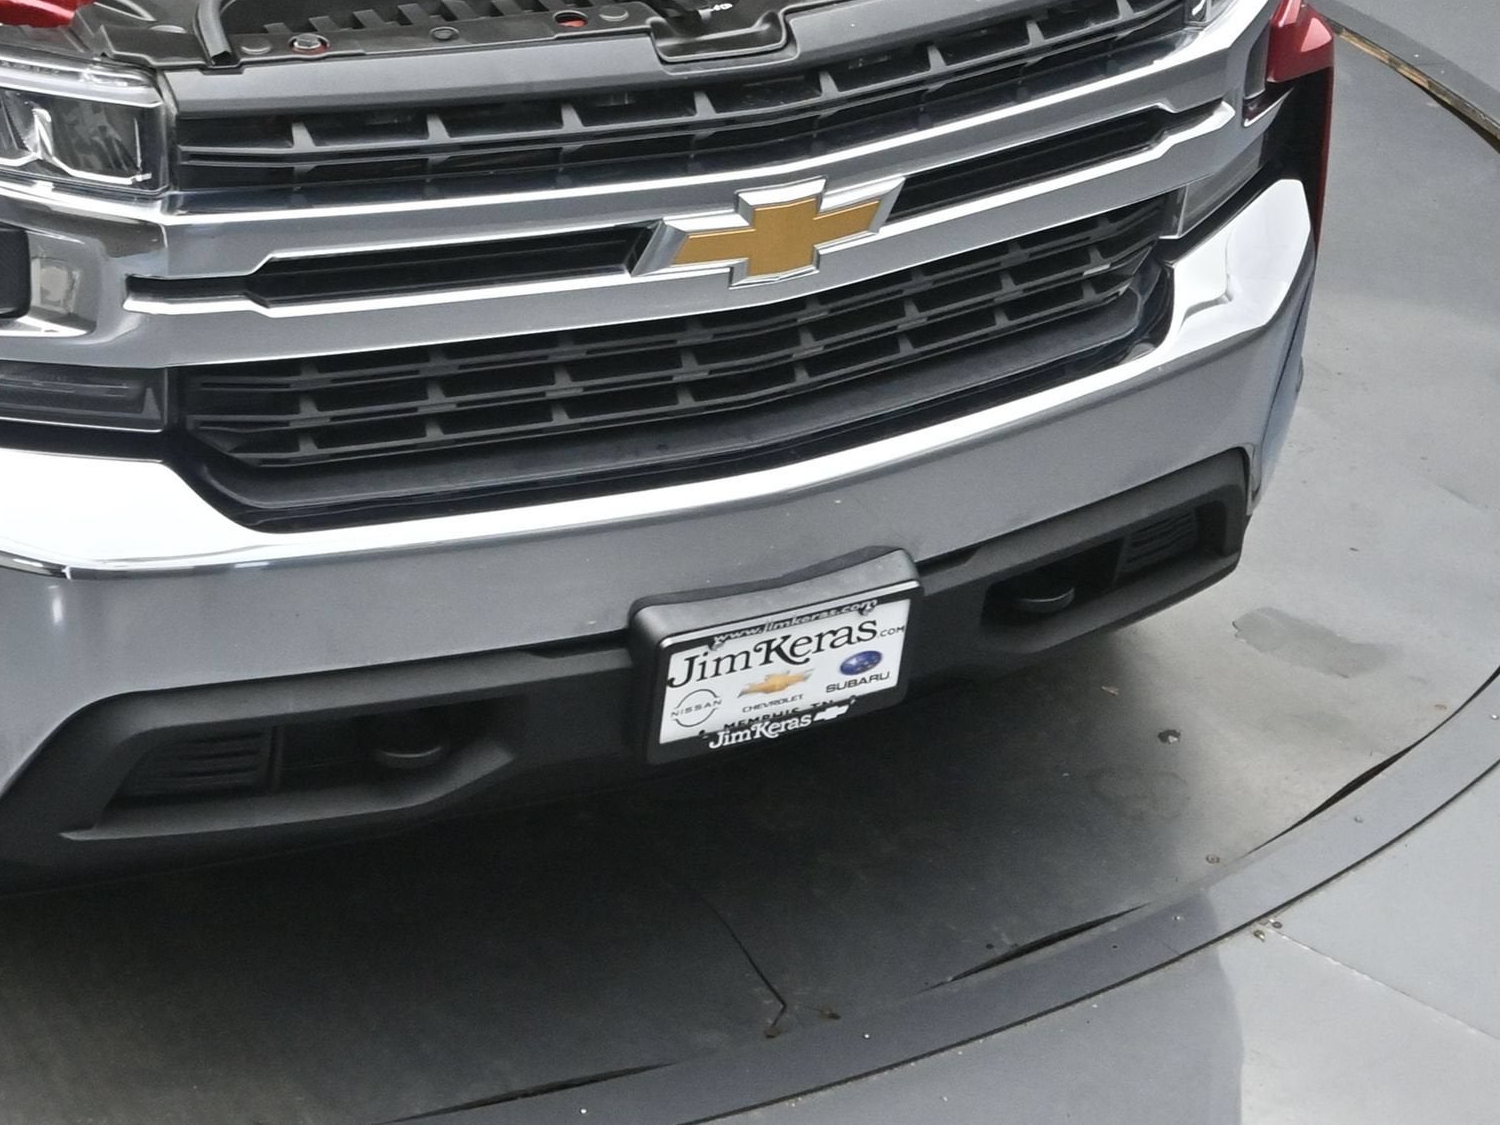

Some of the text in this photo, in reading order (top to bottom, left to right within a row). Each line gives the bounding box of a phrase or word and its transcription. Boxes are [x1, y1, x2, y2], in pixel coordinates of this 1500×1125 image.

[825, 671, 890, 694] SUBARU
[670, 698, 722, 718] NISSAN
[742, 694, 804, 713] CHEVROLET
